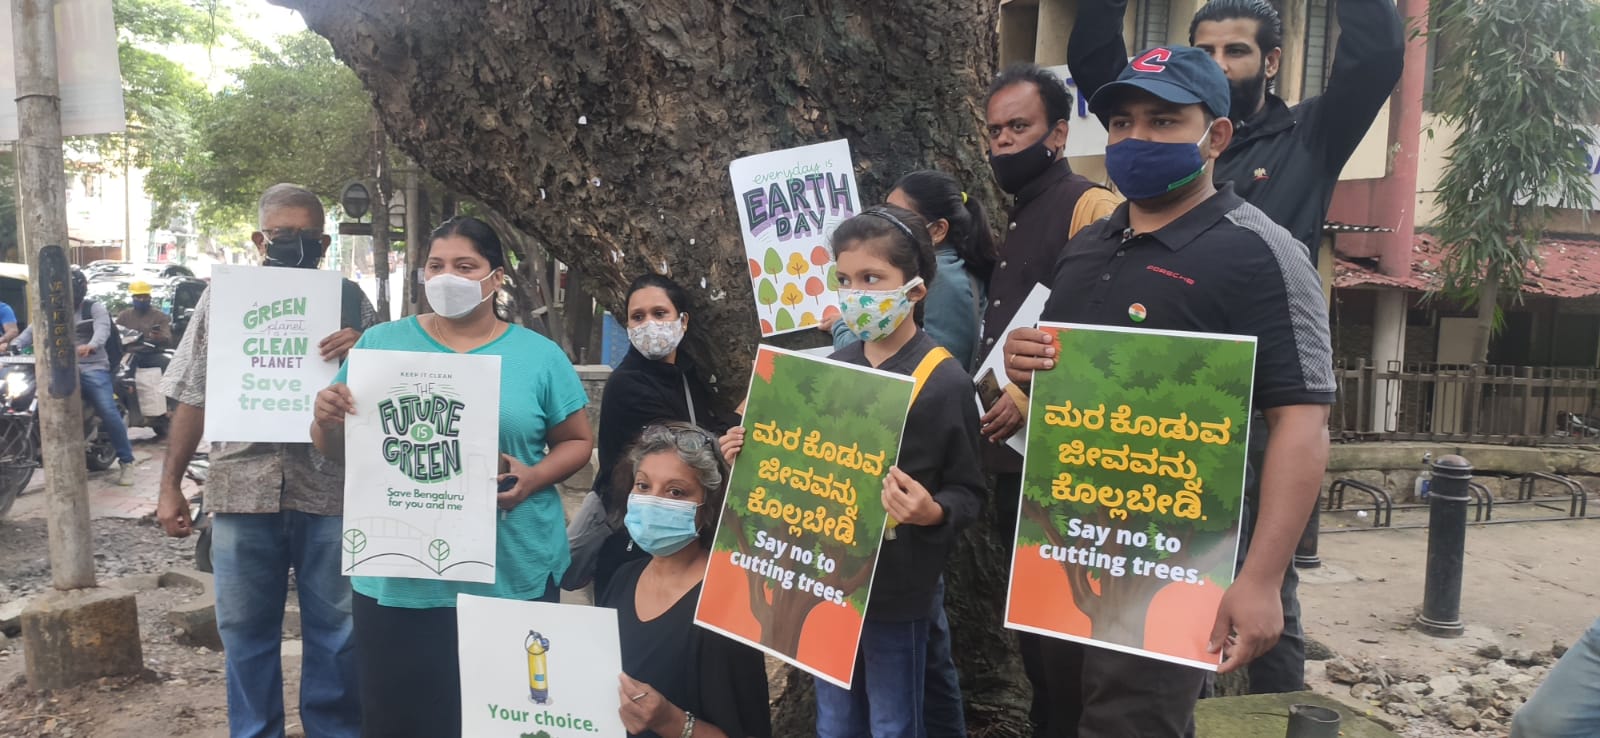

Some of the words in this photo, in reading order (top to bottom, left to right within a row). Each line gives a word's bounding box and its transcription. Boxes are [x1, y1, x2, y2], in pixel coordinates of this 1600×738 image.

[1131, 48, 1172, 72] C
[753, 162, 820, 184] everyday
[743, 172, 854, 235] EARTH
[776, 210, 825, 240] DAY
[243, 297, 307, 330] GREEN
[266, 320, 305, 336] planet
[243, 337, 308, 356] CLEAN
[251, 356, 303, 369] PLANET
[241, 373, 302, 391] Save
[414, 382, 436, 395] THE
[238, 394, 310, 412] trees!
[378, 394, 465, 437] FUTURE
[416, 426, 428, 439] IS
[1043, 400, 1105, 431] ಮರ
[1109, 404, 1232, 446] ಕೊಡುವ
[382, 437, 463, 483] GREEN
[752, 420, 802, 452] ಮರ
[802, 429, 885, 477] ಕೊಡುವ
[1057, 439, 1204, 493] ಜೀವವನ್ನು
[387, 488, 412, 498] Save
[413, 489, 464, 502] Bengaluru
[388, 498, 403, 508] for
[405, 500, 424, 511] you
[426, 499, 445, 510] and
[447, 502, 463, 511] me
[757, 457, 858, 520] ಜೀವವನ್ನು
[1050, 472, 1208, 521] ಕೊಲ್ಲಬೇಡಿ.
[747, 486, 857, 547] ಕೊಲ್ಲಬೇಡಿ.
[754, 530, 788, 560] Say
[790, 541, 813, 565] no
[816, 550, 836, 574] to
[1067, 518, 1112, 547] Say
[1116, 527, 1148, 548] no
[1154, 530, 1181, 553] to
[730, 550, 796, 591] cutting
[797, 572, 848, 608] trees.
[1039, 542, 1127, 578] cutting
[1132, 555, 1204, 586] trees.
[488, 703, 530, 723] Your
[534, 710, 599, 732] choice.
